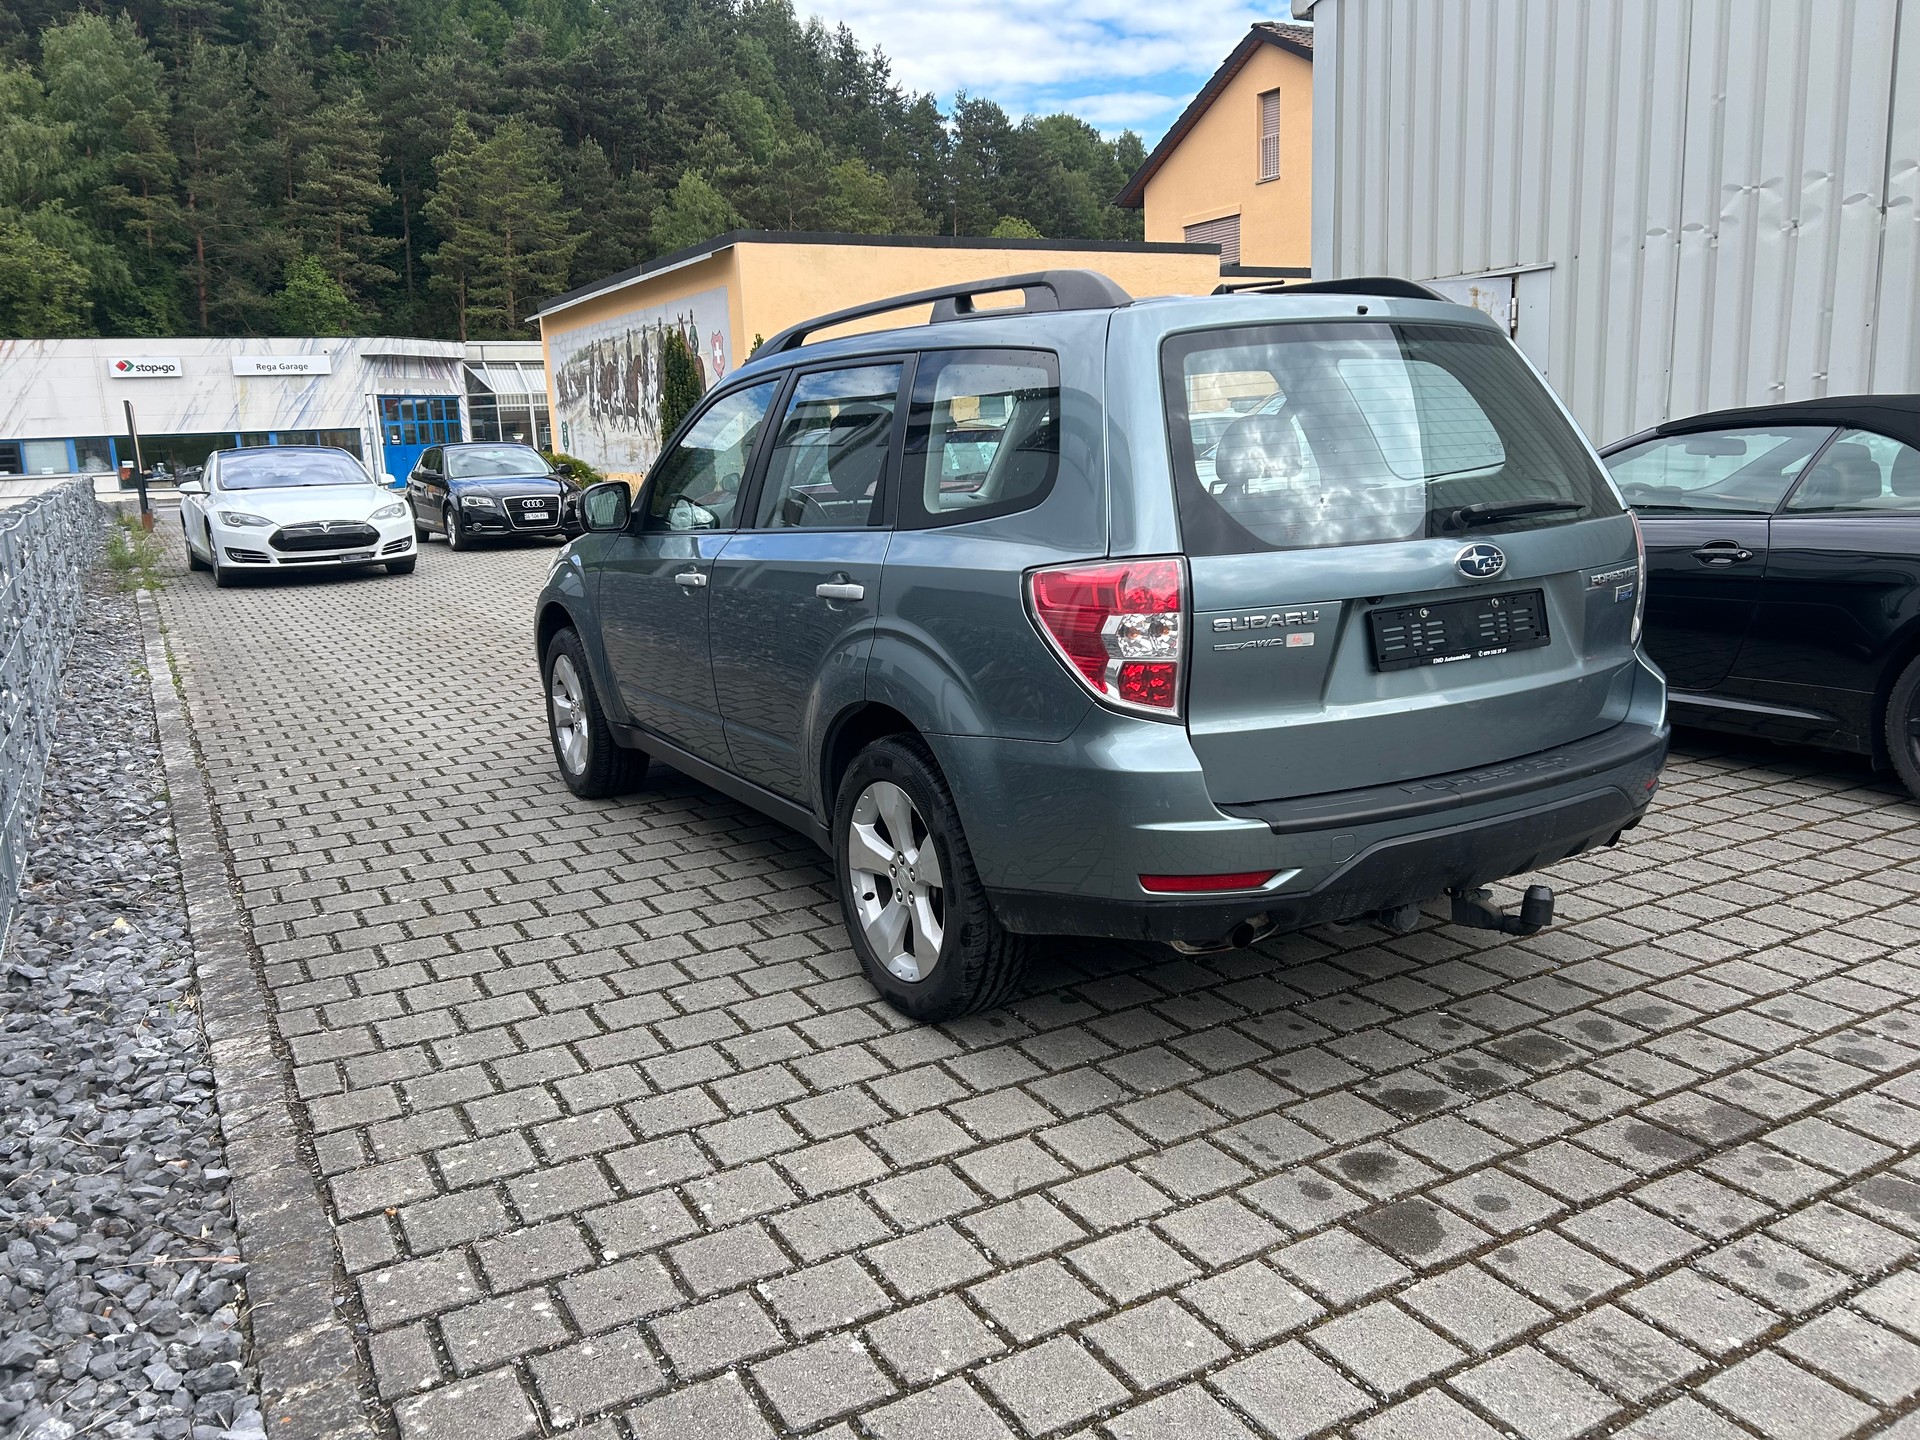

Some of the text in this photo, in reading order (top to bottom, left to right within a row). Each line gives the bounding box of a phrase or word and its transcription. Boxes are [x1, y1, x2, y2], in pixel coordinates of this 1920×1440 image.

[135, 363, 175, 373] stop+go
[256, 363, 309, 372] Rega Garage
[1213, 610, 1319, 632] SUBARU
[1240, 638, 1284, 650] AWD
[1398, 757, 1571, 795] FORESTER
